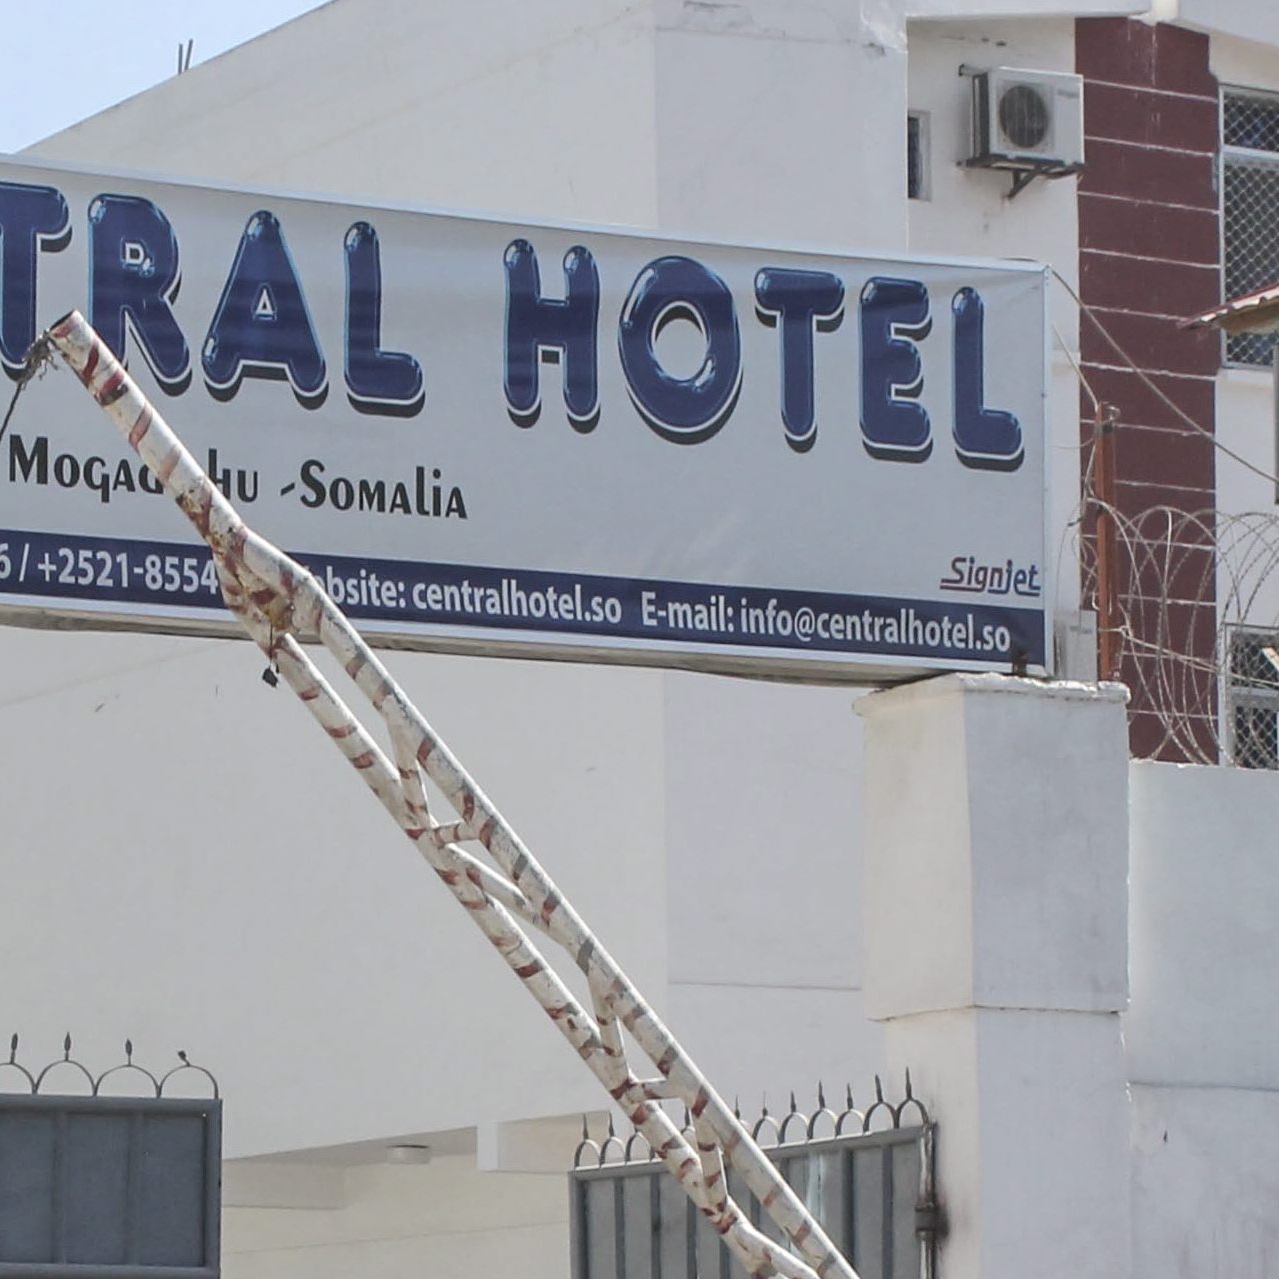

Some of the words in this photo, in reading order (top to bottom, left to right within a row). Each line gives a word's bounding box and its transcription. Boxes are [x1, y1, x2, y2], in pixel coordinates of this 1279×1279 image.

[503, 238, 1024, 473] HOTEL
[304, 562, 406, 609] bsite:
[412, 578, 623, 625] centralhotel.so
[641, 590, 735, 633] E-mail:
[741, 598, 1011, 652] info@centralhotel.so
[940, 555, 1041, 597] Signjet
